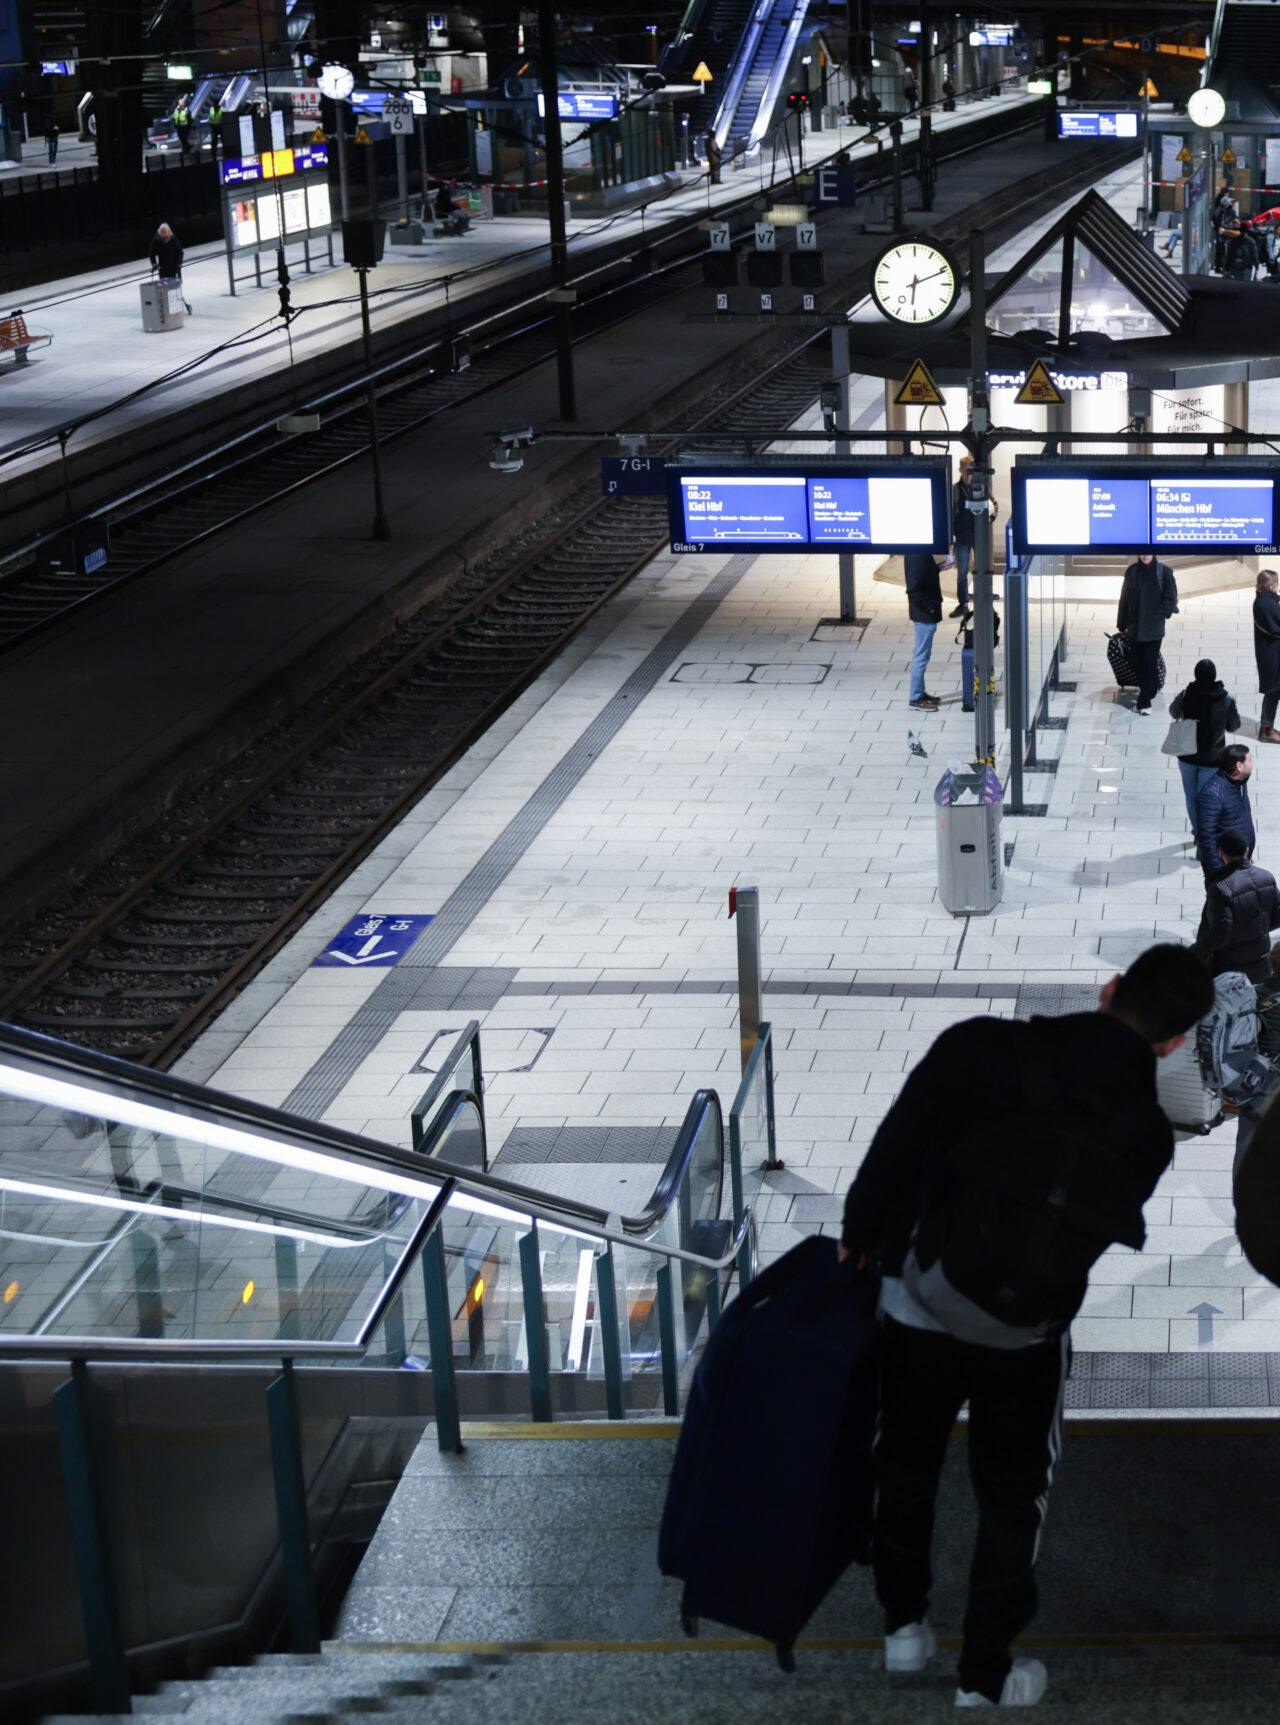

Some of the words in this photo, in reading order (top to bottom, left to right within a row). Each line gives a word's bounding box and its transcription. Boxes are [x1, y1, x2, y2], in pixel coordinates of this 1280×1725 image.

[1141, 38, 1152, 52] D
[383, 100, 410, 115] 286
[393, 117, 403, 130] 6
[819, 171, 839, 201] E
[713, 231, 727, 244] r7
[758, 231, 773, 244] v7
[800, 231, 813, 244] t7
[1175, 411, 1188, 421] Für
[620, 459, 629, 471] 7
[1156, 493, 1179, 502] 06:34
[689, 501, 705, 511] Kiel
[706, 501, 723, 511] Hbf
[1156, 503, 1195, 514] München
[1196, 503, 1213, 514] Hbf
[673, 543, 697, 551] Gleis
[699, 543, 705, 551] 7
[1254, 544, 1277, 553] Gleis
[354, 919, 384, 936] Gleis
